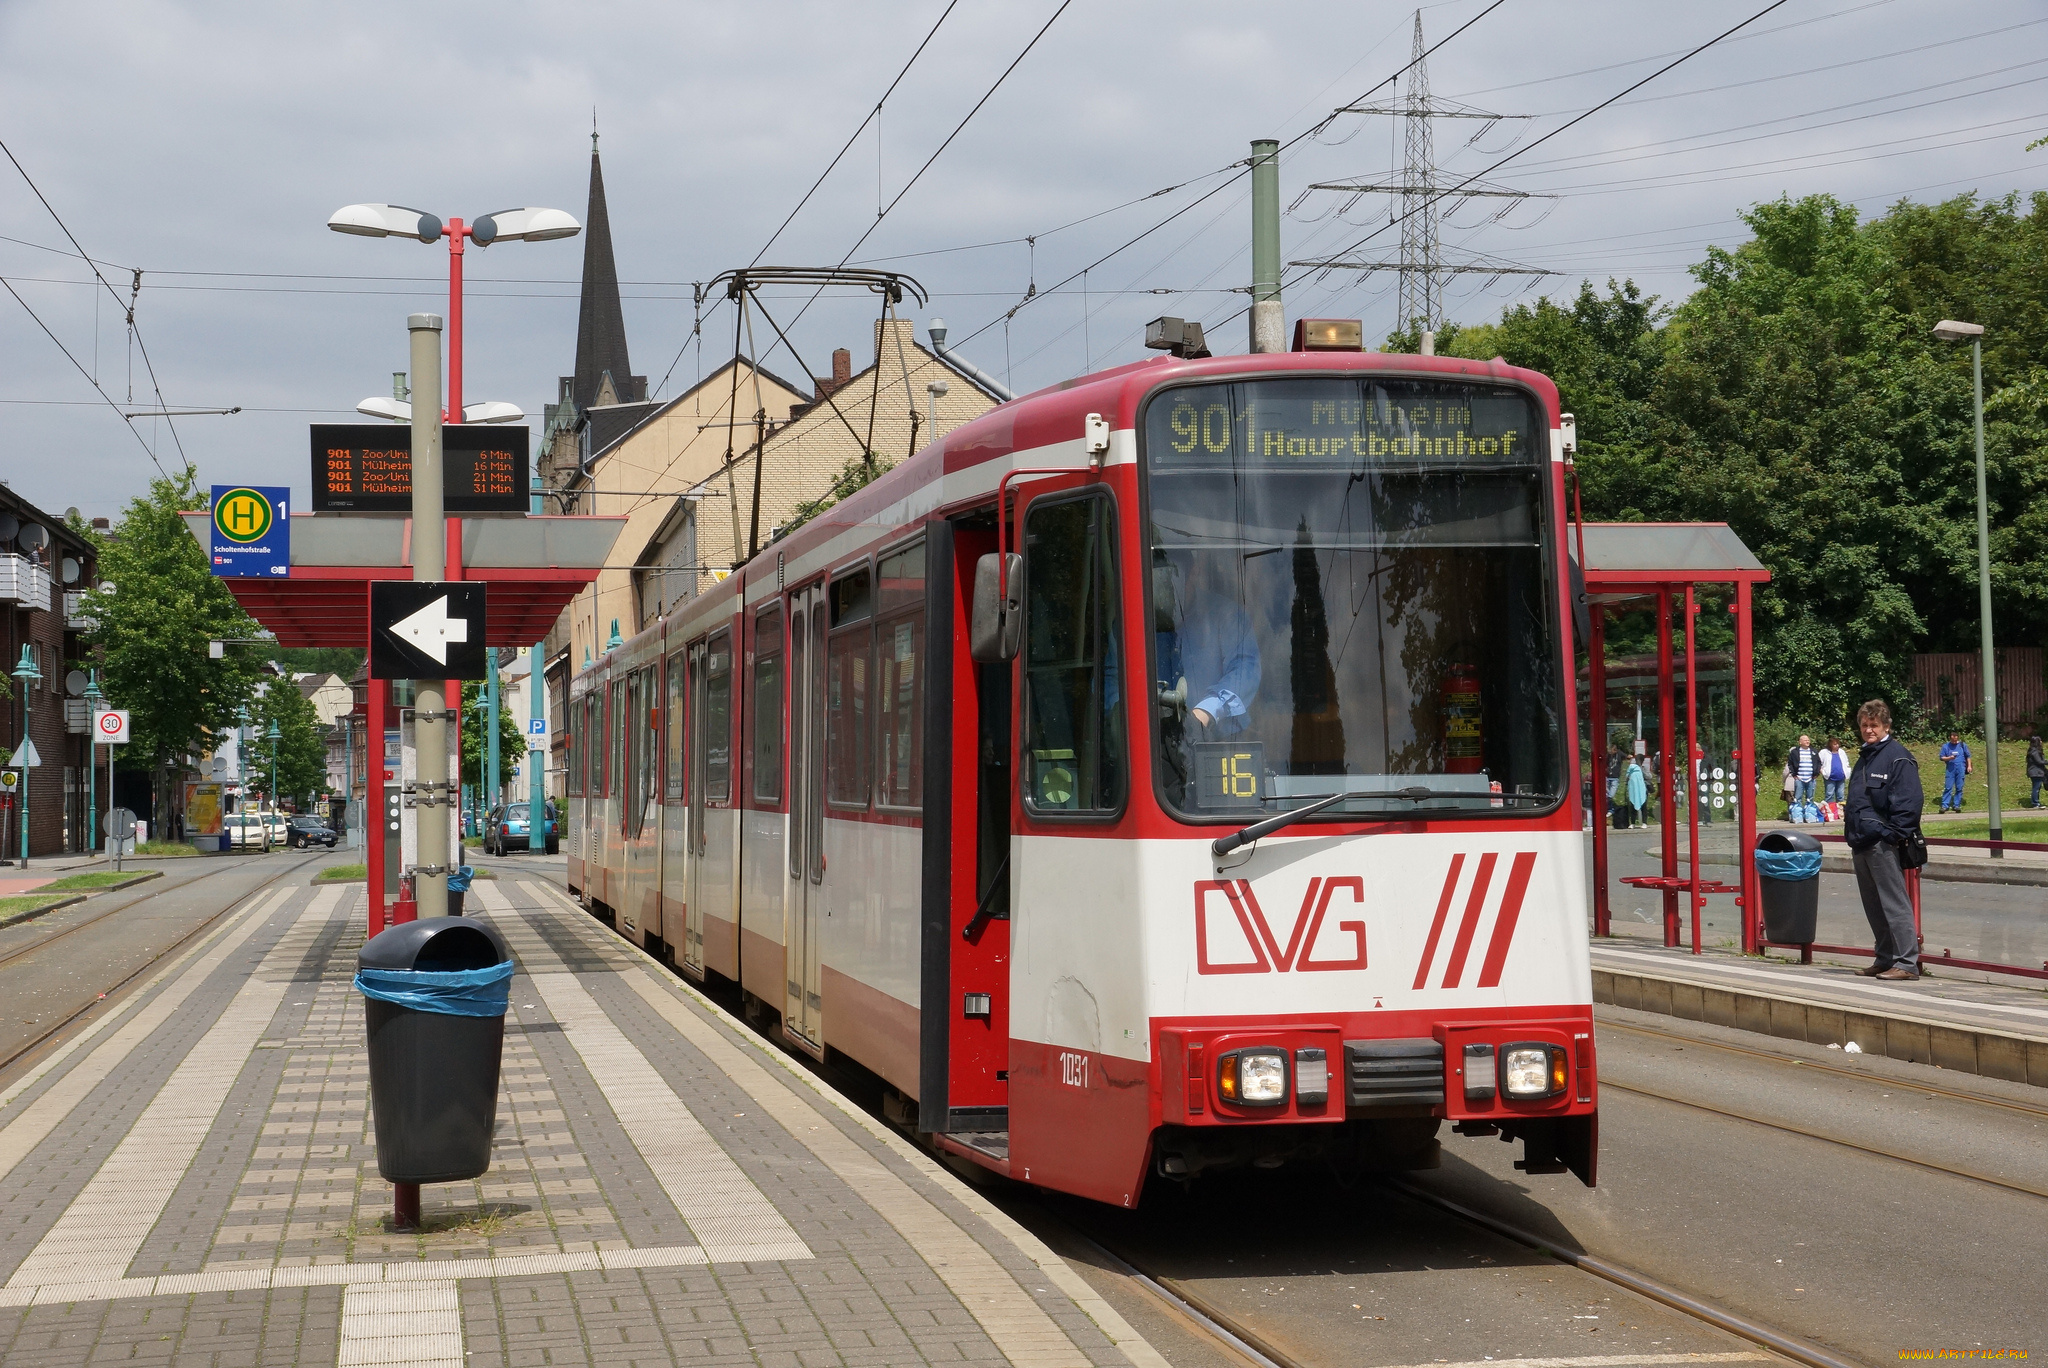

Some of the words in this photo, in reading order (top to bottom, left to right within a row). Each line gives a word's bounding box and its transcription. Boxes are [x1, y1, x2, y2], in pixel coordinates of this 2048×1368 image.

[1312, 400, 1471, 426] Mülheim
[1171, 403, 1256, 453] 901
[1263, 430, 1518, 457] Hauptbahnhof
[327, 449, 352, 459] 901
[362, 450, 409, 459] Zoo/Uni
[480, 451, 486, 460] 6
[490, 451, 514, 460] Min.
[327, 460, 352, 470] 901
[362, 460, 412, 470] Mülheim
[474, 462, 486, 471] 16
[490, 462, 514, 471] Min.
[327, 472, 352, 481] 901
[362, 472, 409, 481] Zoo/Uni
[473, 473, 486, 482] 21
[490, 473, 514, 482] Min.
[327, 483, 352, 492] 901
[362, 483, 412, 493] Mülheim
[473, 484, 486, 493] 31
[490, 484, 514, 493] Min.
[232, 501, 254, 530] H
[277, 501, 286, 520] 1
[214, 546, 271, 554] Scholtenhofstraße
[104, 718, 118, 729] 30
[532, 720, 543, 734] P
[1221, 753, 1257, 797] 16
[1194, 876, 1368, 975] DVG
[1059, 1051, 1089, 1089] 1031
[1124, 1193, 1129, 1207] 2
